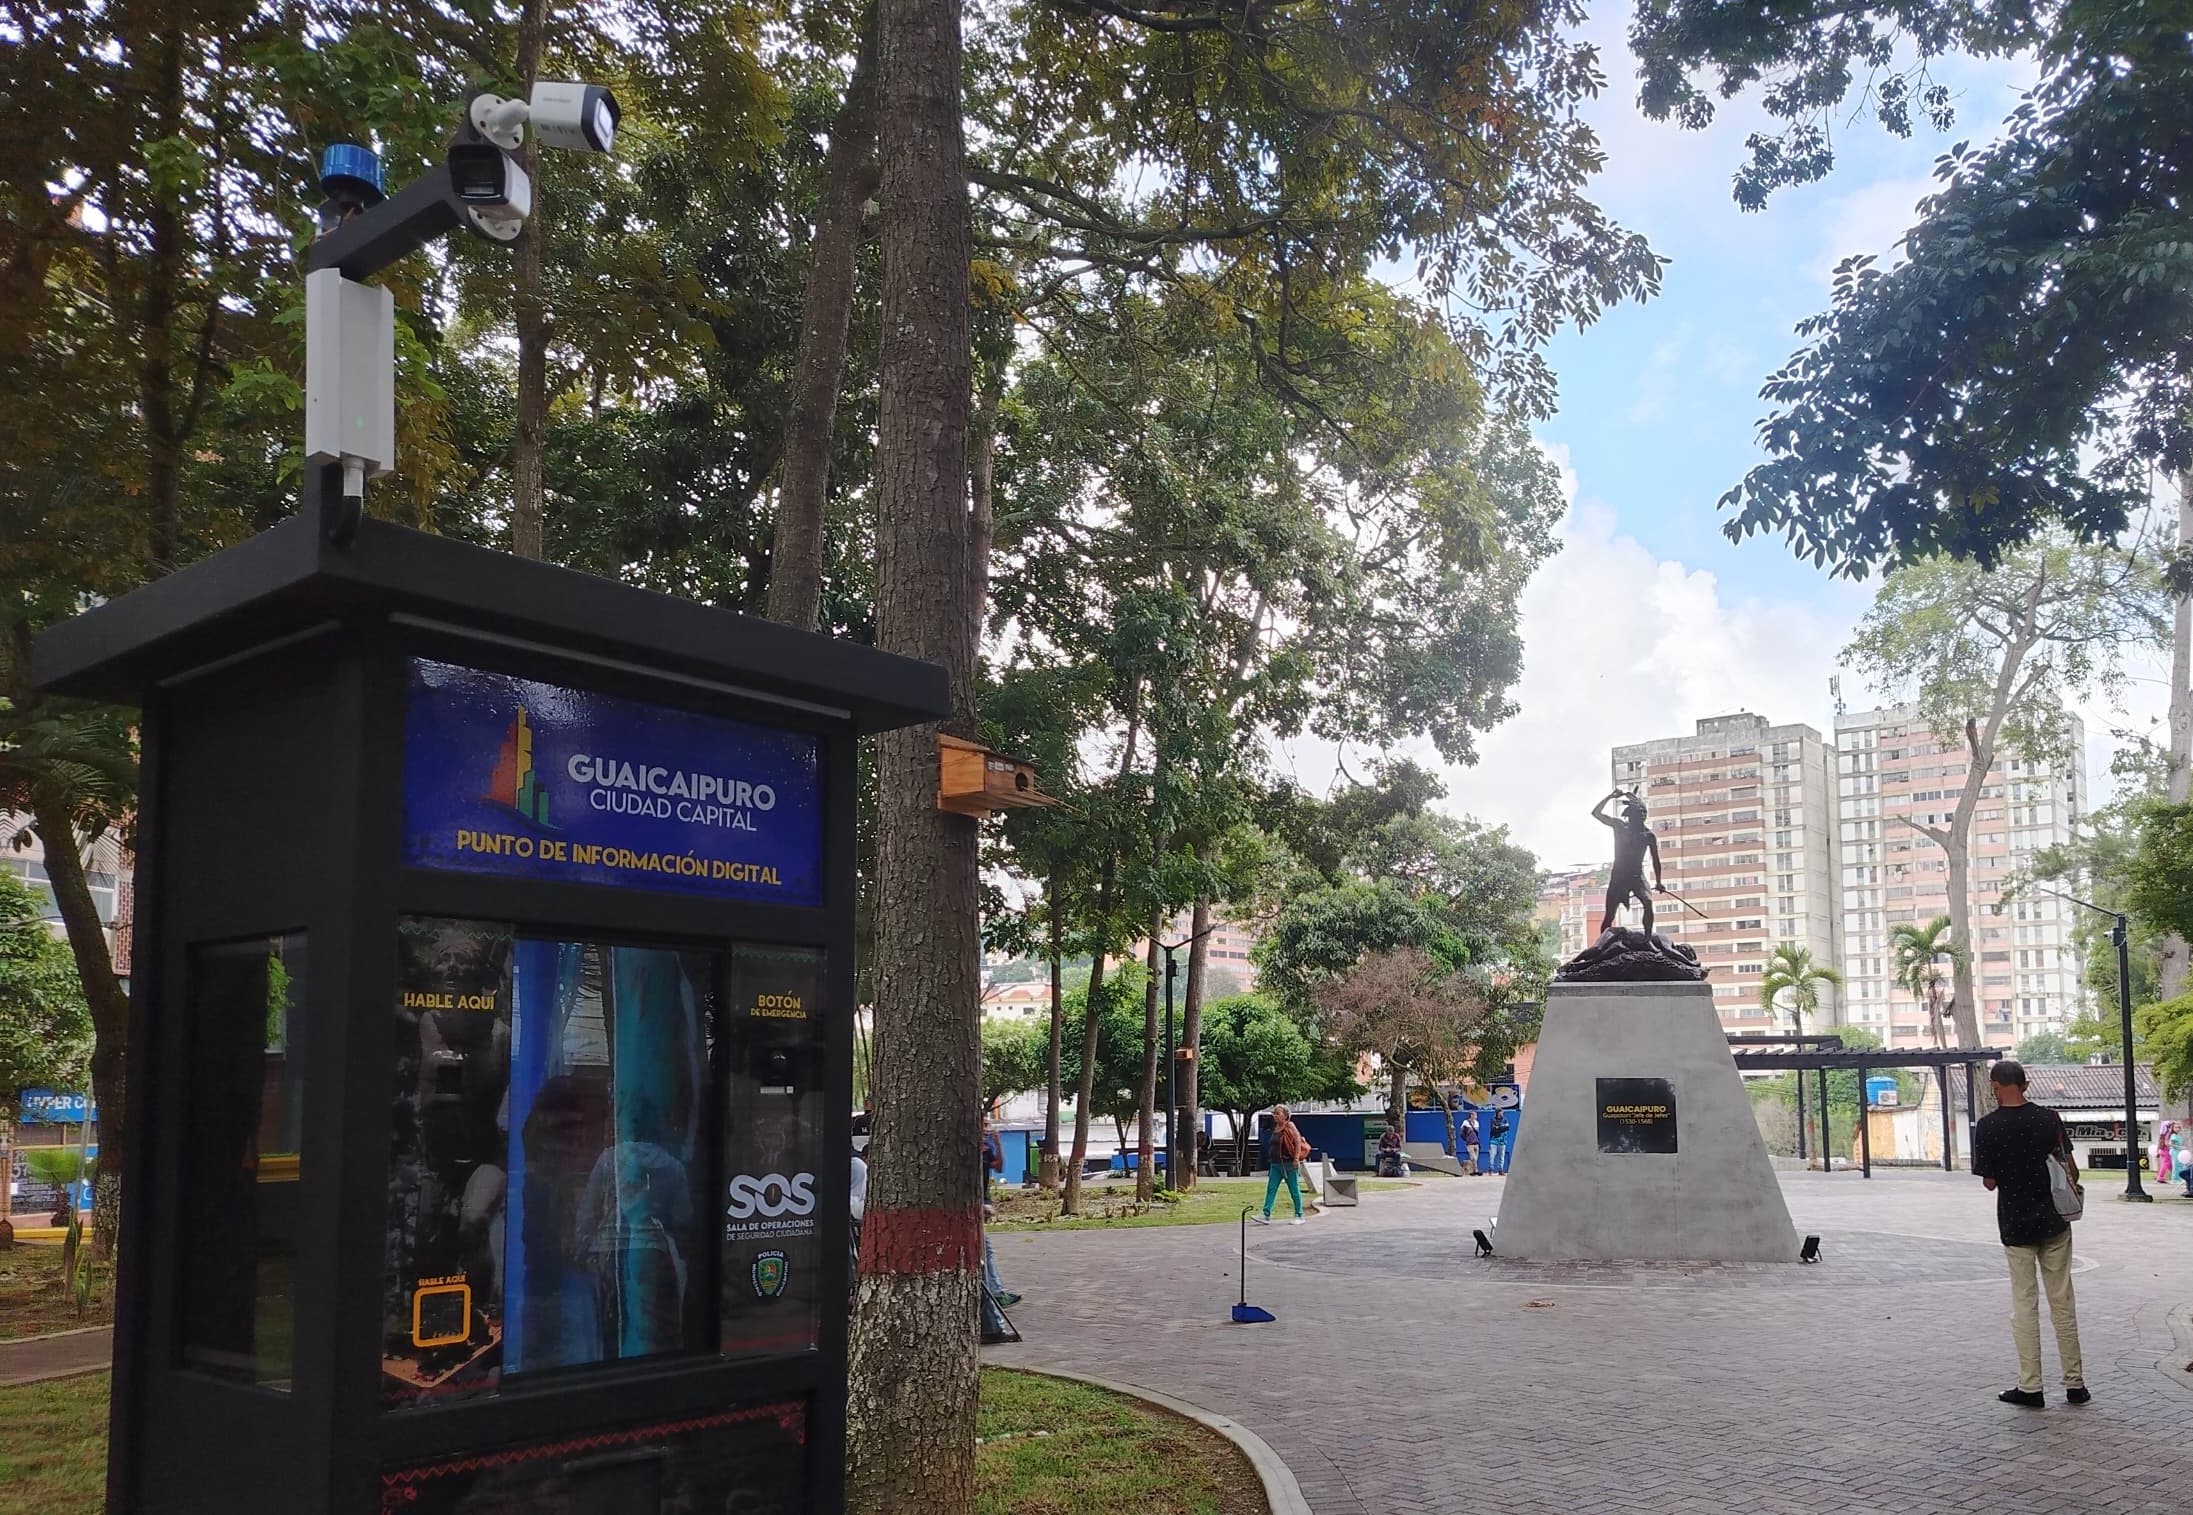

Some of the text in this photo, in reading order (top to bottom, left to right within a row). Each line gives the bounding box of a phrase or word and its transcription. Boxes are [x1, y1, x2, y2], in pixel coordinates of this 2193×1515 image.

[567, 754, 776, 811] GUAICAIPURO
[590, 789, 757, 832] CIUDAD CAPITAL
[457, 829, 782, 885] PUNTO DE INFORMACIÓN DIGITAL
[404, 988, 496, 1010] HABLE AQUÍ
[758, 990, 800, 1009] BOTÓN
[750, 1008, 760, 1017] DE
[1606, 1105, 1666, 1113] GUAICAIPURO
[727, 1172, 816, 1219] SOS
[726, 1219, 815, 1233] SALA DE OPERACIONES
[726, 1227, 814, 1241] DE SEGURIDAD CIUDADANA
[418, 1277, 445, 1286] HABLE
